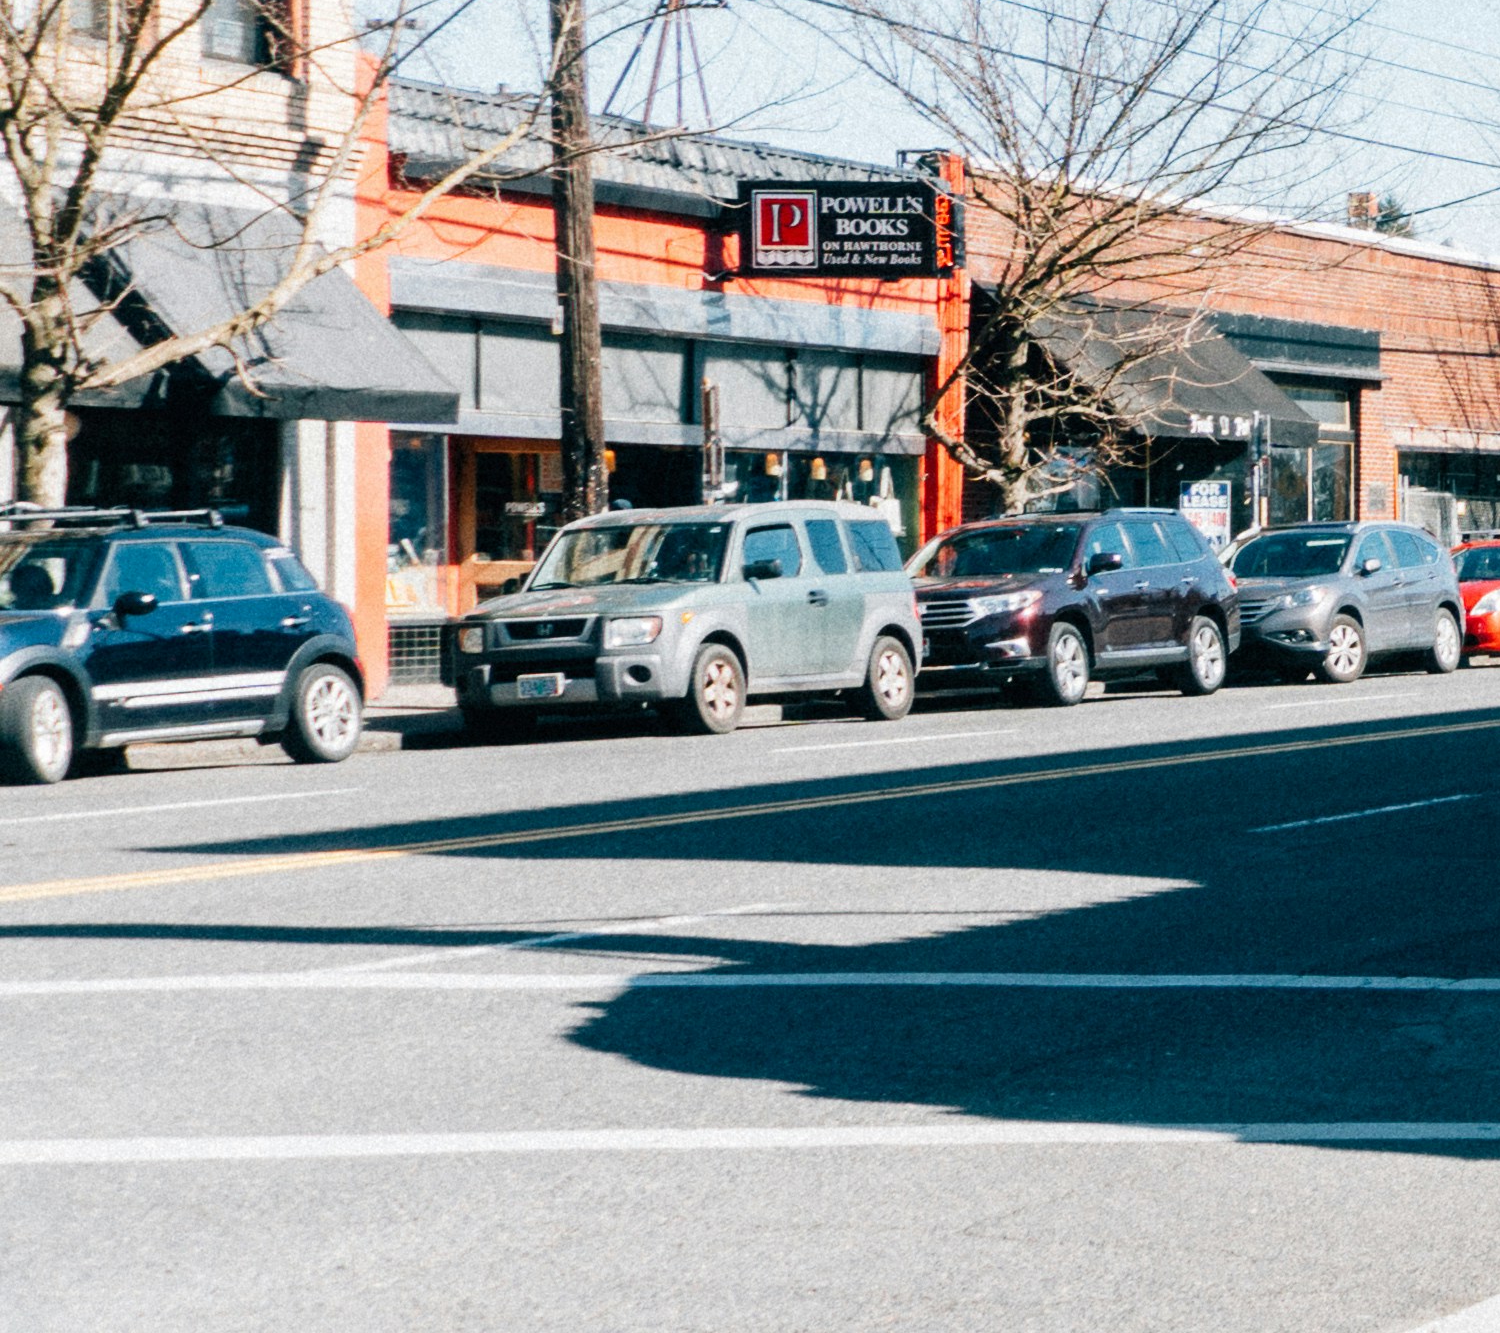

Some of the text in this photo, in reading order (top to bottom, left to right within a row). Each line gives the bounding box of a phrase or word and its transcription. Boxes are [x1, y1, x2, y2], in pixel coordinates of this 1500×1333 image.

[820, 196, 923, 214] POWELL'S
[836, 218, 909, 235] BOOKS
[822, 241, 922, 251] ON HAWTHORNE
[852, 254, 861, 264] &
[863, 254, 886, 264] New
[889, 253, 922, 265] Books
[1191, 483, 1220, 495] FOR
[1182, 495, 1228, 508] LEASE
